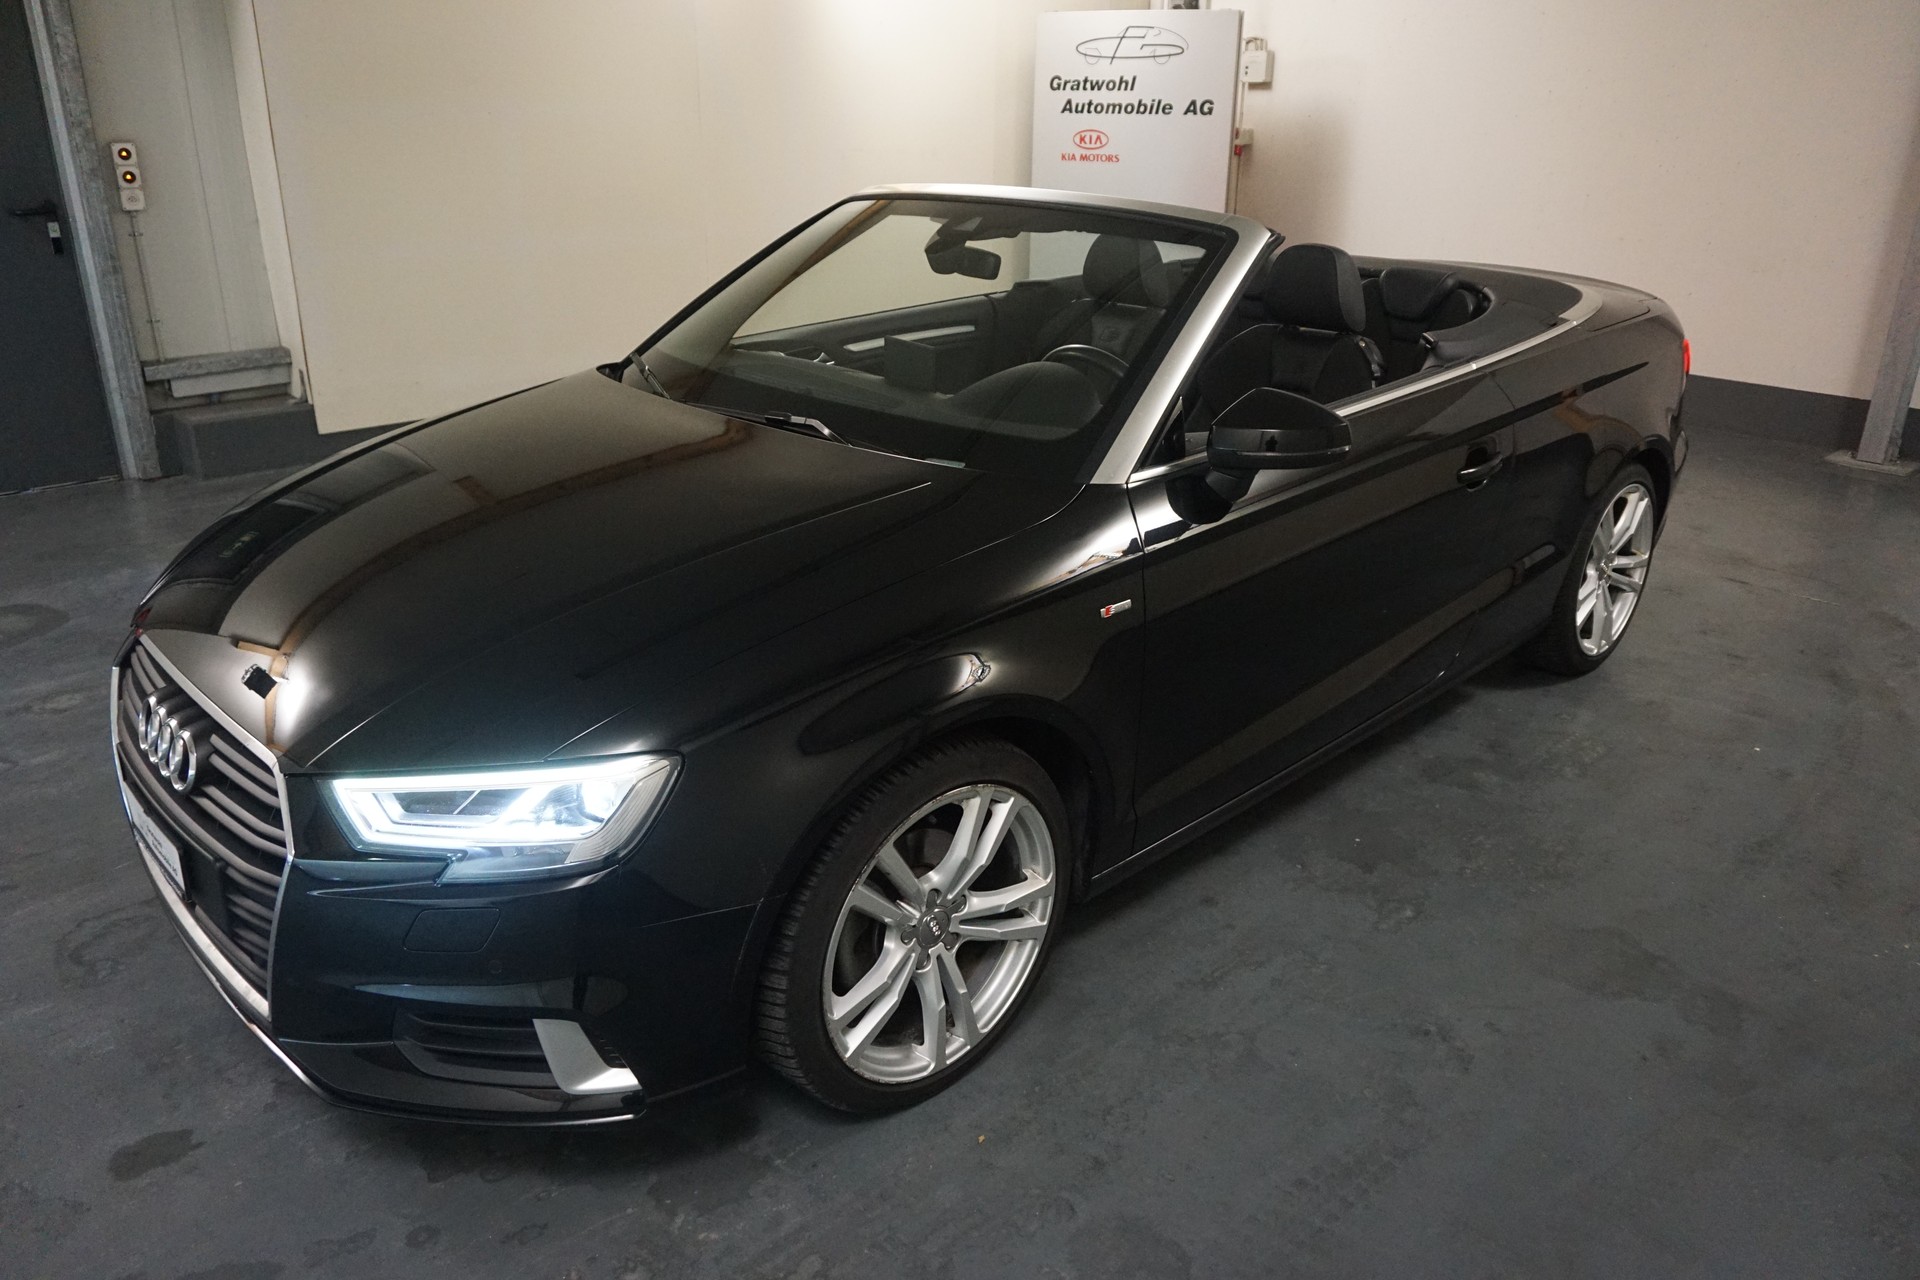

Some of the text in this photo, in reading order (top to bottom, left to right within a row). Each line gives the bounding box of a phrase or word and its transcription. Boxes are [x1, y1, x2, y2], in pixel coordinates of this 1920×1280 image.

[1049, 74, 1137, 92] Gratwohl
[1060, 98, 1215, 116] Automobile AG
[1078, 133, 1103, 145] KIA
[1061, 152, 1120, 163] KIA MOTORS
